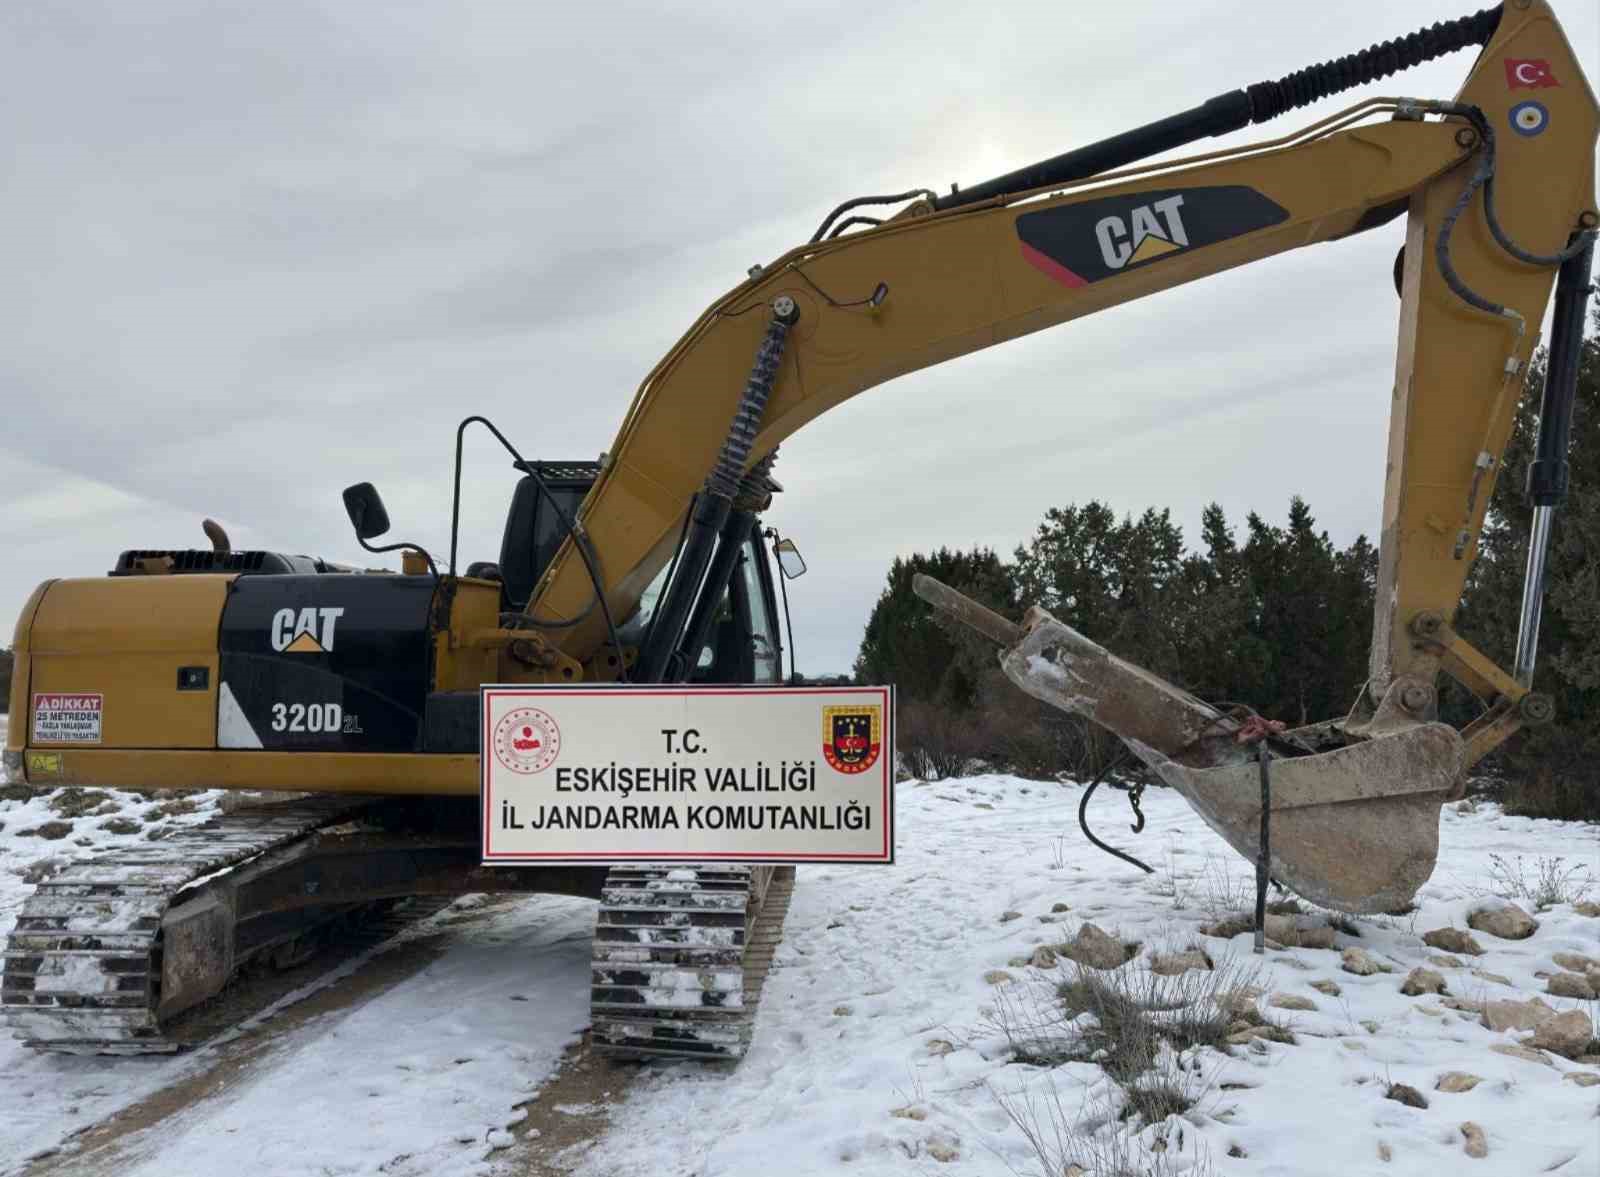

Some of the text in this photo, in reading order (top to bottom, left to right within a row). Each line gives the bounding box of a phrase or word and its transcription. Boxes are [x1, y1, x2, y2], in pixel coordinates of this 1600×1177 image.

[1095, 194, 1189, 269] CAT
[271, 607, 345, 652] CAT
[37, 712, 98, 721] 25 METREDEN
[51, 696, 98, 709] DİKKAT
[271, 702, 342, 732] 320D
[662, 728, 707, 754] T.C.
[556, 760, 816, 798] ESKİŞEHİR VALİLİĞİ
[502, 799, 871, 831] İL JANDARMA KOMUTANLIĞI
